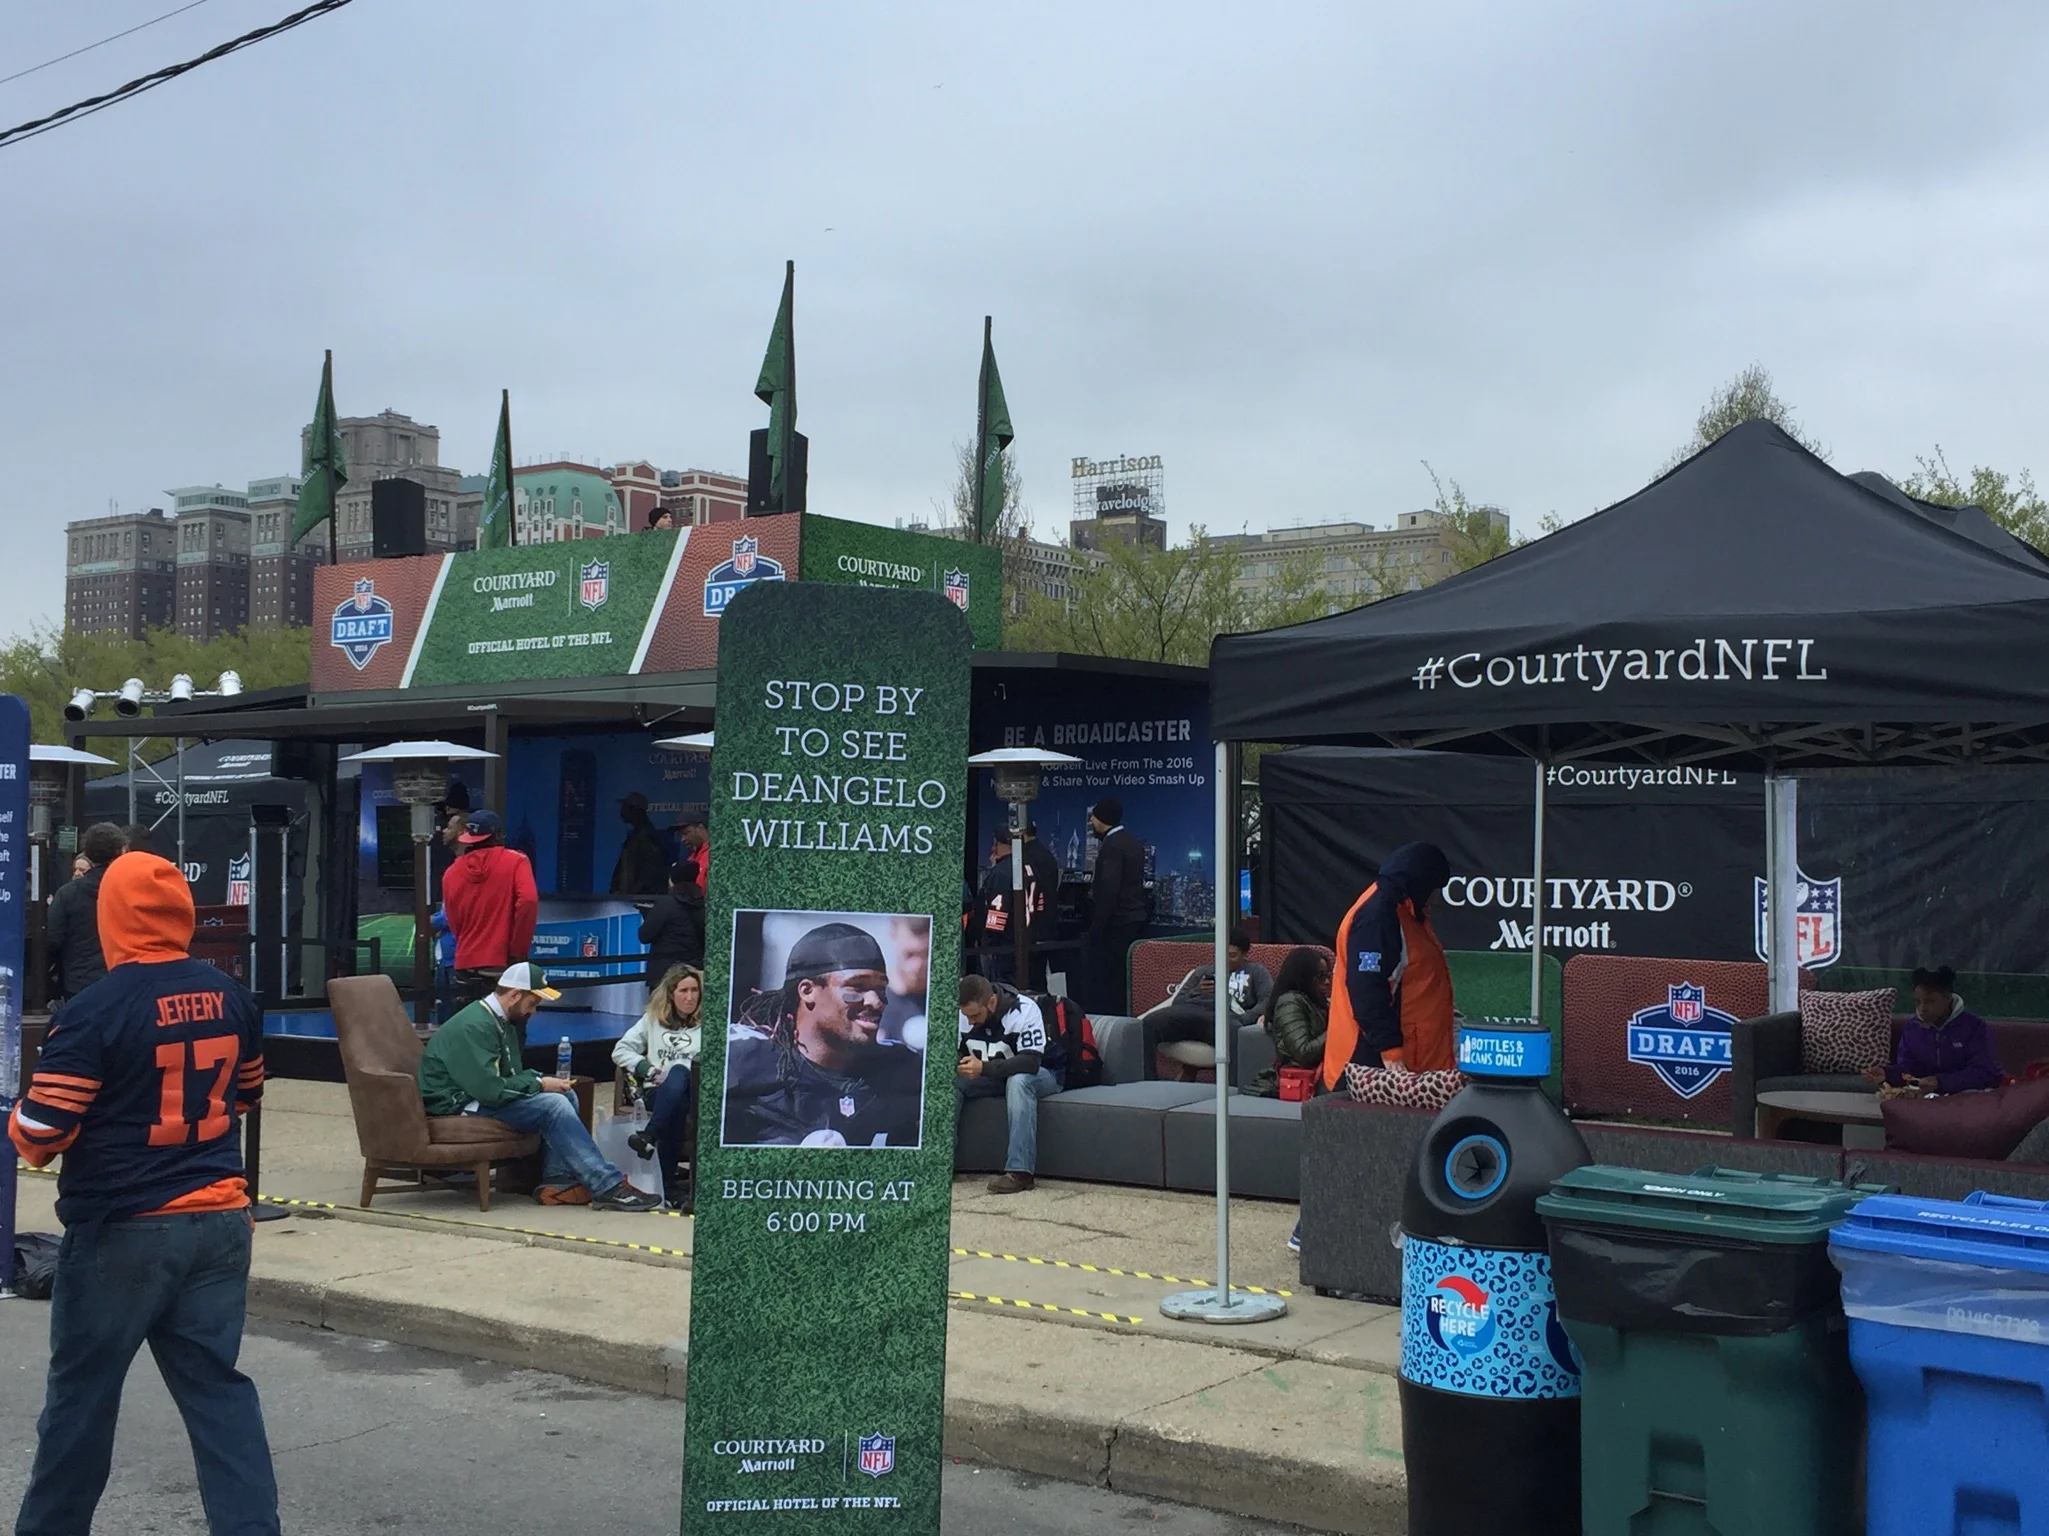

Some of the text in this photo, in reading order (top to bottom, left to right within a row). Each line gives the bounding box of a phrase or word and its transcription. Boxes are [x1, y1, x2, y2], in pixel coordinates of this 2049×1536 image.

[1071, 453, 1163, 478] Harrison
[736, 554, 754, 570] NFL
[838, 555, 921, 583] COURTYARD
[473, 570, 556, 593] COURTYARD
[582, 582, 605, 601] NFL
[490, 596, 534, 613] Marriott
[336, 620, 388, 638] DRAFT
[468, 631, 613, 654] OFFICIAL HOTEL OF THE NFL
[1411, 638, 1828, 692] #CourtyardNFL
[764, 680, 924, 716] STOP BY
[1004, 719, 1191, 746] BE A BROADCASTER
[775, 727, 907, 761] TO SEE
[1085, 760, 1107, 771] Live
[1111, 759, 1139, 770] From
[1143, 757, 1164, 769] The
[1166, 757, 1193, 769] 2016
[1042, 772, 1205, 788] & Share Your Video Smash Up
[1546, 765, 1737, 790] #CourtyardNFL
[732, 772, 946, 808] DEANGELO
[741, 818, 934, 854] WILLIAMS
[231, 883, 249, 905] NF
[1489, 918, 1611, 950] Marriott
[155, 991, 224, 1027] JEFFERY
[1673, 1002, 1699, 1020] NFL
[1021, 1029, 1043, 1048] 82
[1471, 1037, 1525, 1053] BOTTLES &
[1637, 1032, 1732, 1058] DRAFT
[1471, 1053, 1524, 1067] CANS ONLY
[1674, 1066, 1699, 1077] 2016
[147, 1034, 240, 1146] 17
[721, 1179, 915, 1201] BEGINNING AT
[766, 1212, 867, 1233] 6:00 PM
[1917, 1211, 2032, 1229] RECYCLABLES
[1431, 1297, 1489, 1321] RECYCLE
[1440, 1318, 1476, 1337] HERE
[714, 1439, 825, 1455] COURTYARD
[737, 1458, 796, 1474] Marriott
[862, 1451, 890, 1471] NFL
[706, 1496, 901, 1512] OFFICIAL HOTEL OF THE NFL
